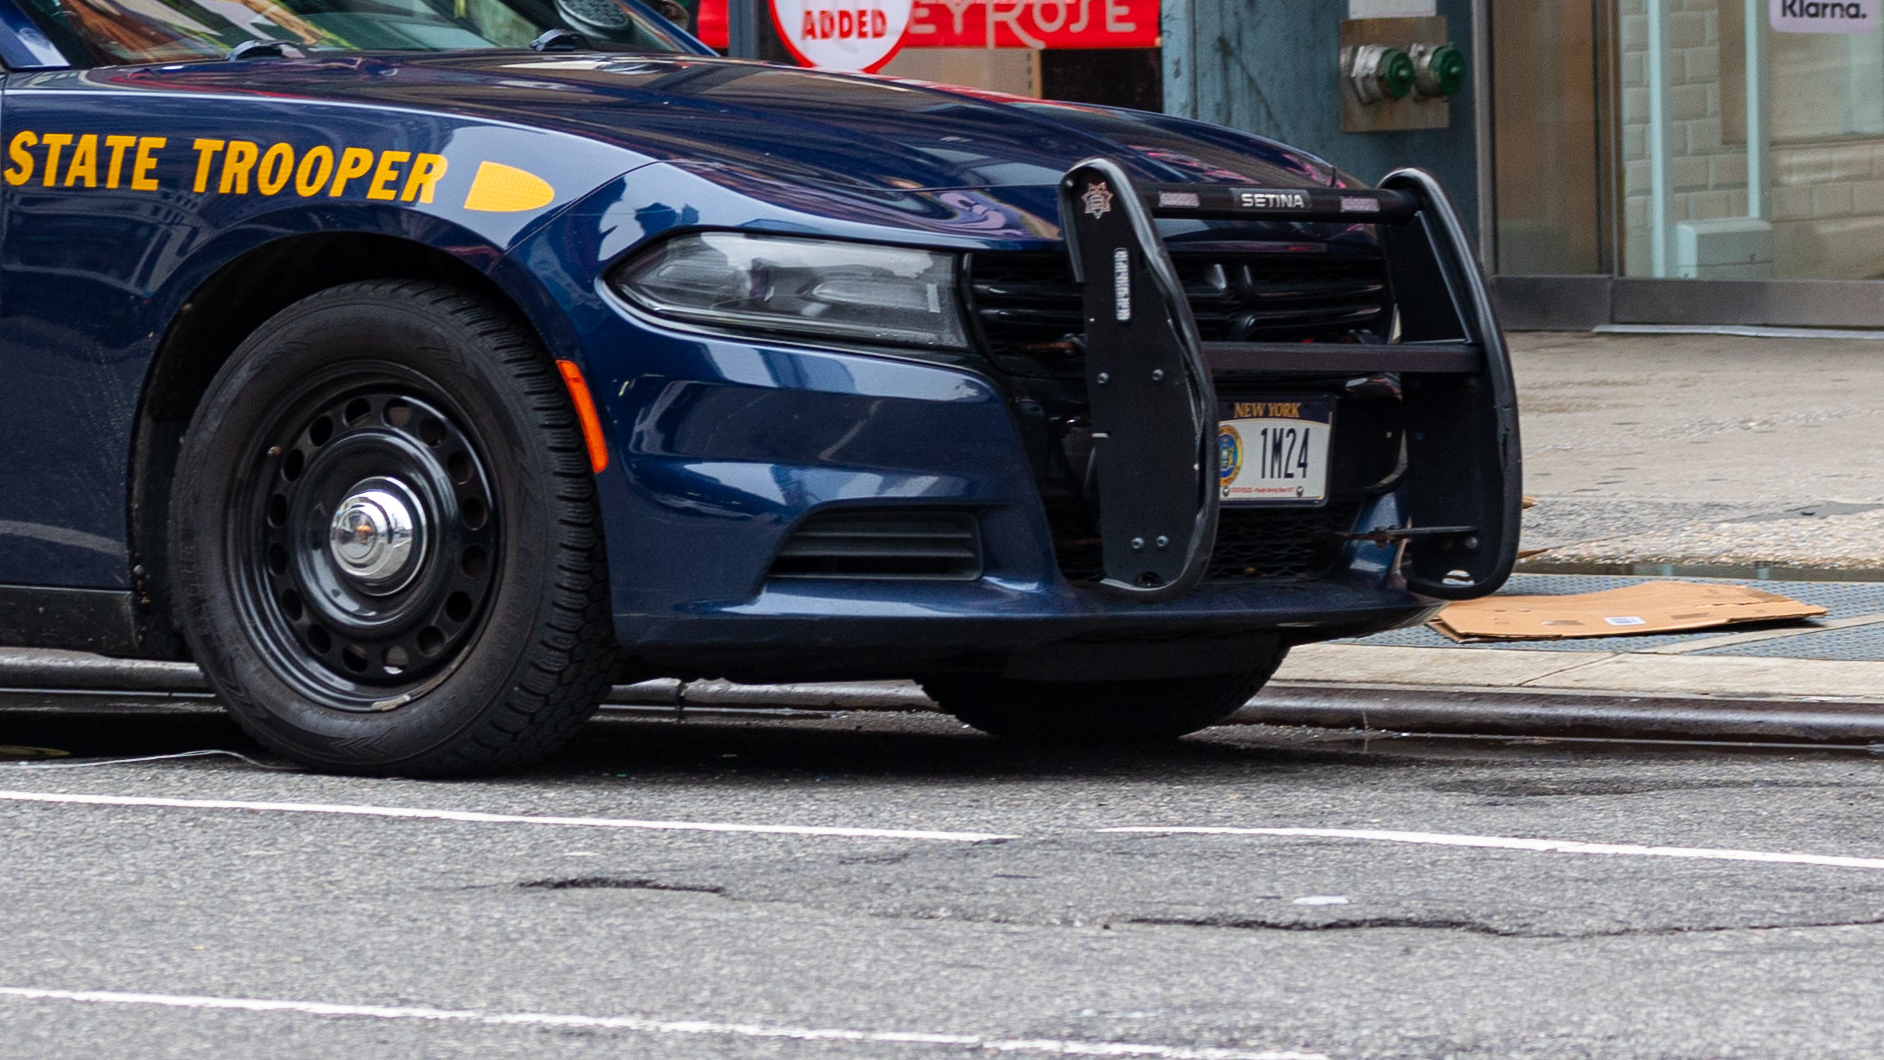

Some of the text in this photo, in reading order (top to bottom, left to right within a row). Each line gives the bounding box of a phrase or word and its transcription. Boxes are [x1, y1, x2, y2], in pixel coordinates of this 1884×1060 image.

[800, 8, 887, 41] ADDED
[3, 130, 448, 205] STATE TROOPER
[1240, 192, 1306, 209] SETINA
[1233, 402, 1303, 419] NEW YORK
[1260, 427, 1311, 480] 1M24
